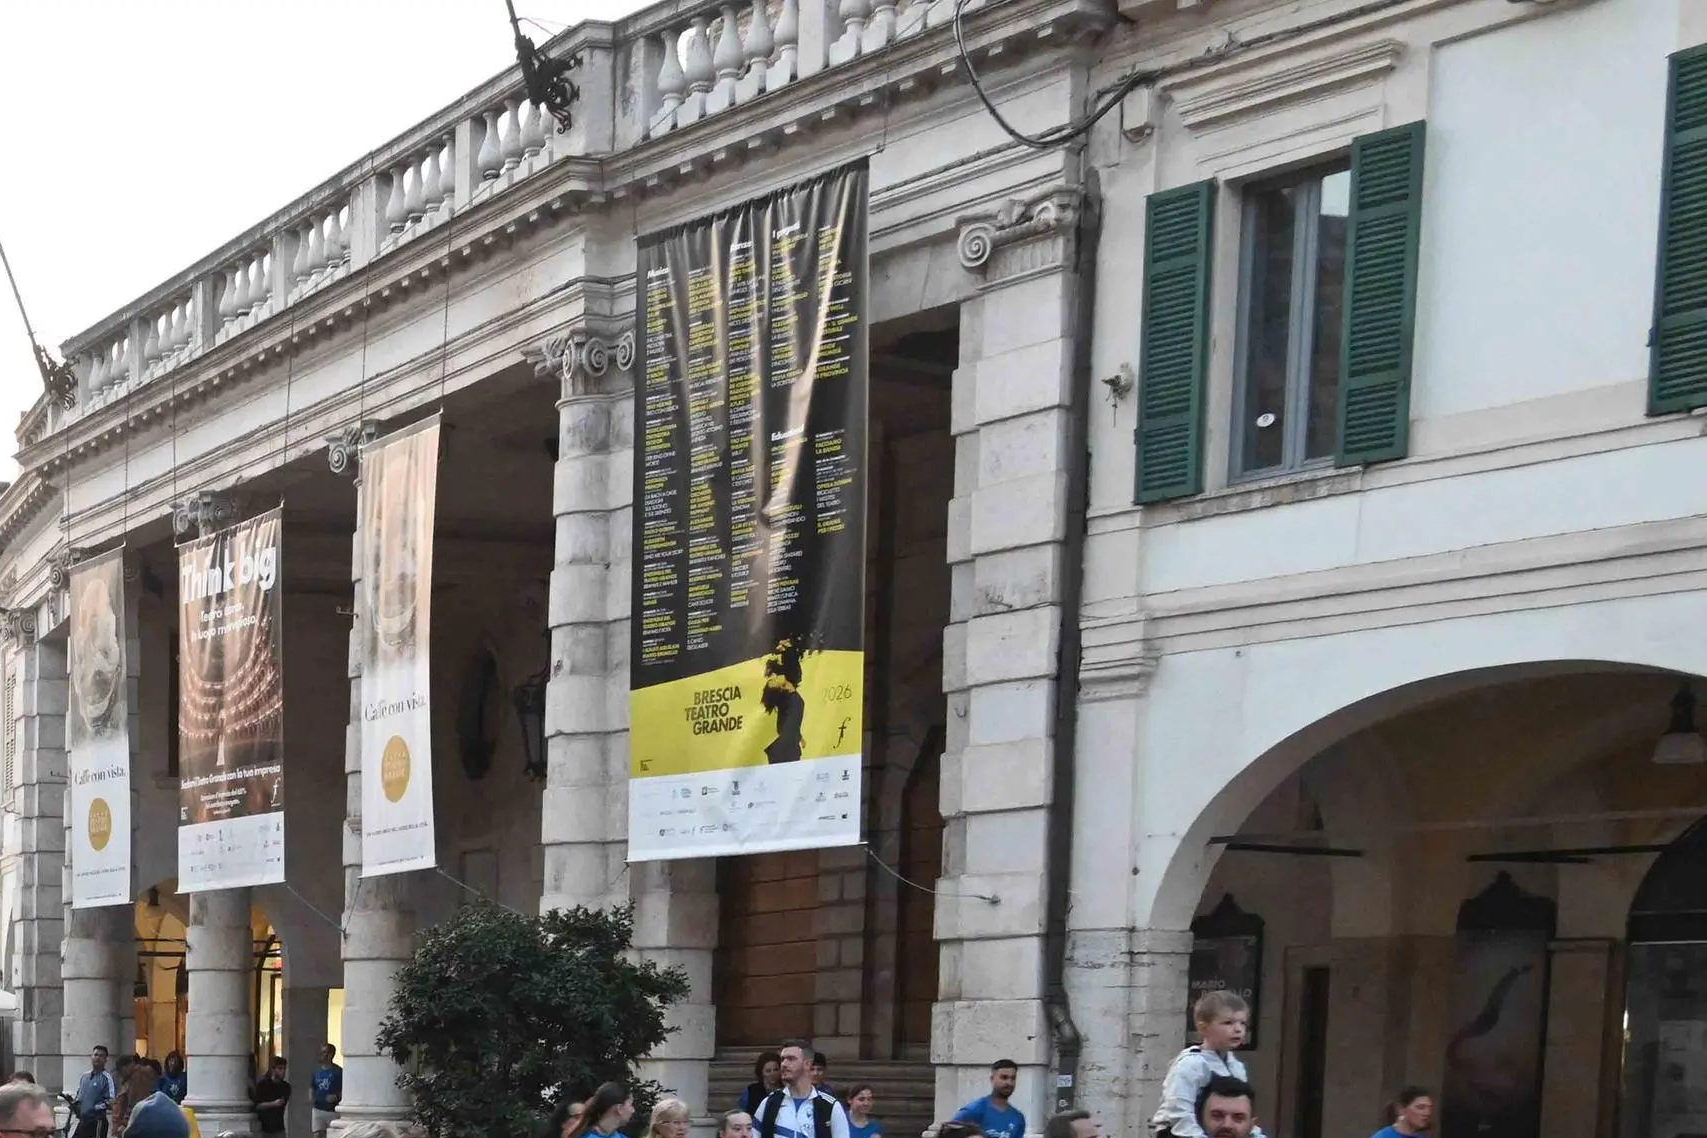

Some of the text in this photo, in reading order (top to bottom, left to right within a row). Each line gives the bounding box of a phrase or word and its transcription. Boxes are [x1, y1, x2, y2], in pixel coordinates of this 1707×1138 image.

[693, 685, 742, 706] BRESCIA
[821, 683, 852, 704] 2026
[684, 702, 730, 722] TEATRO
[693, 715, 743, 736] GRANDE
[254, 764, 281, 777] impresa
